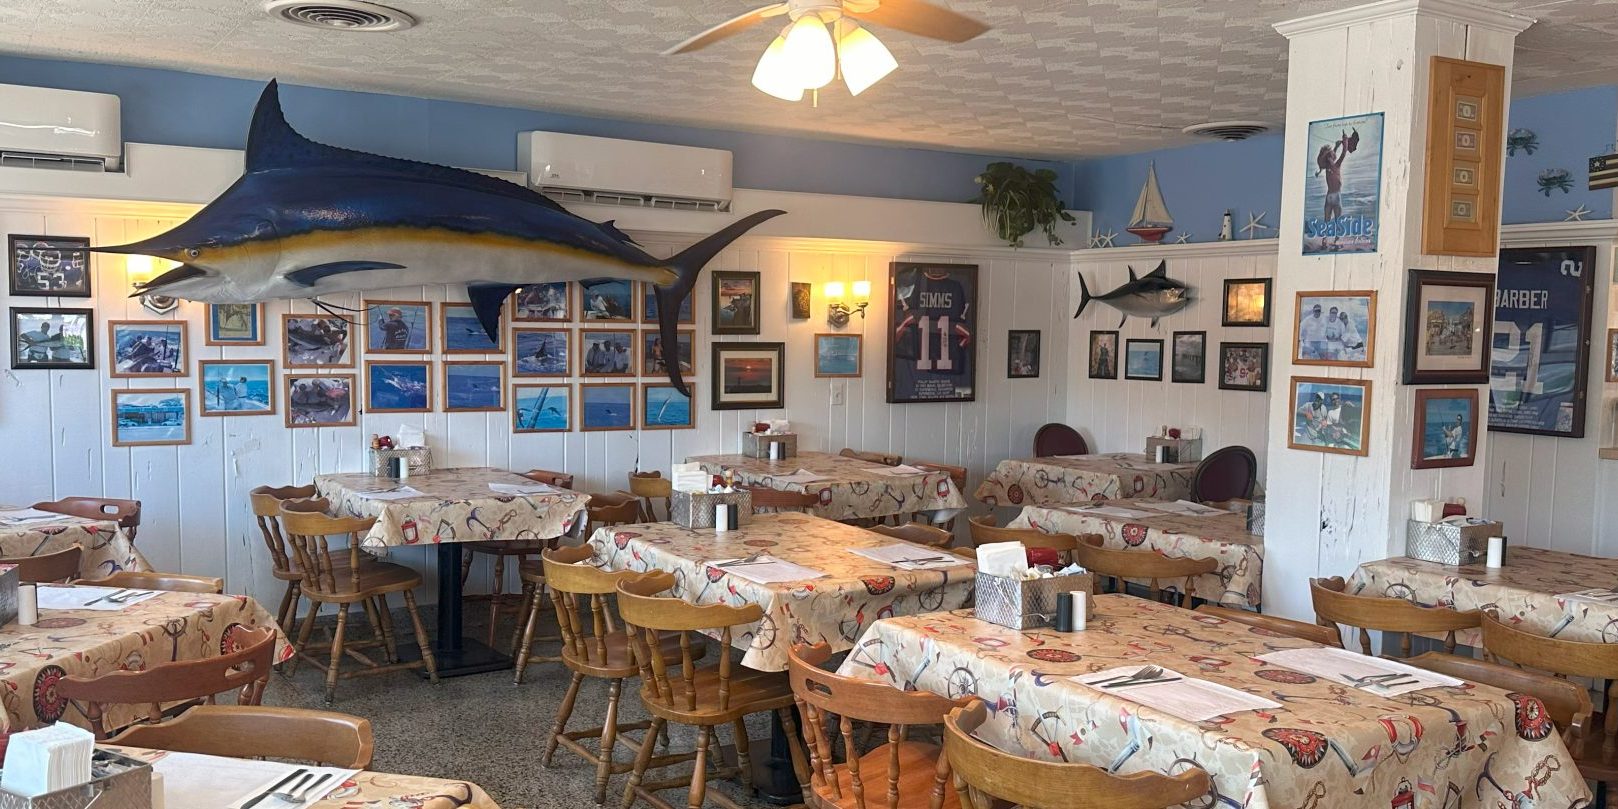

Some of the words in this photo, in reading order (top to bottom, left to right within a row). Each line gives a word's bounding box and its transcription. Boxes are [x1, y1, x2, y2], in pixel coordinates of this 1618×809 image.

[1306, 215, 1374, 238] SeaSide
[919, 292, 953, 309] SIMMS
[917, 315, 953, 370] 11
[1491, 320, 1544, 394] 21
